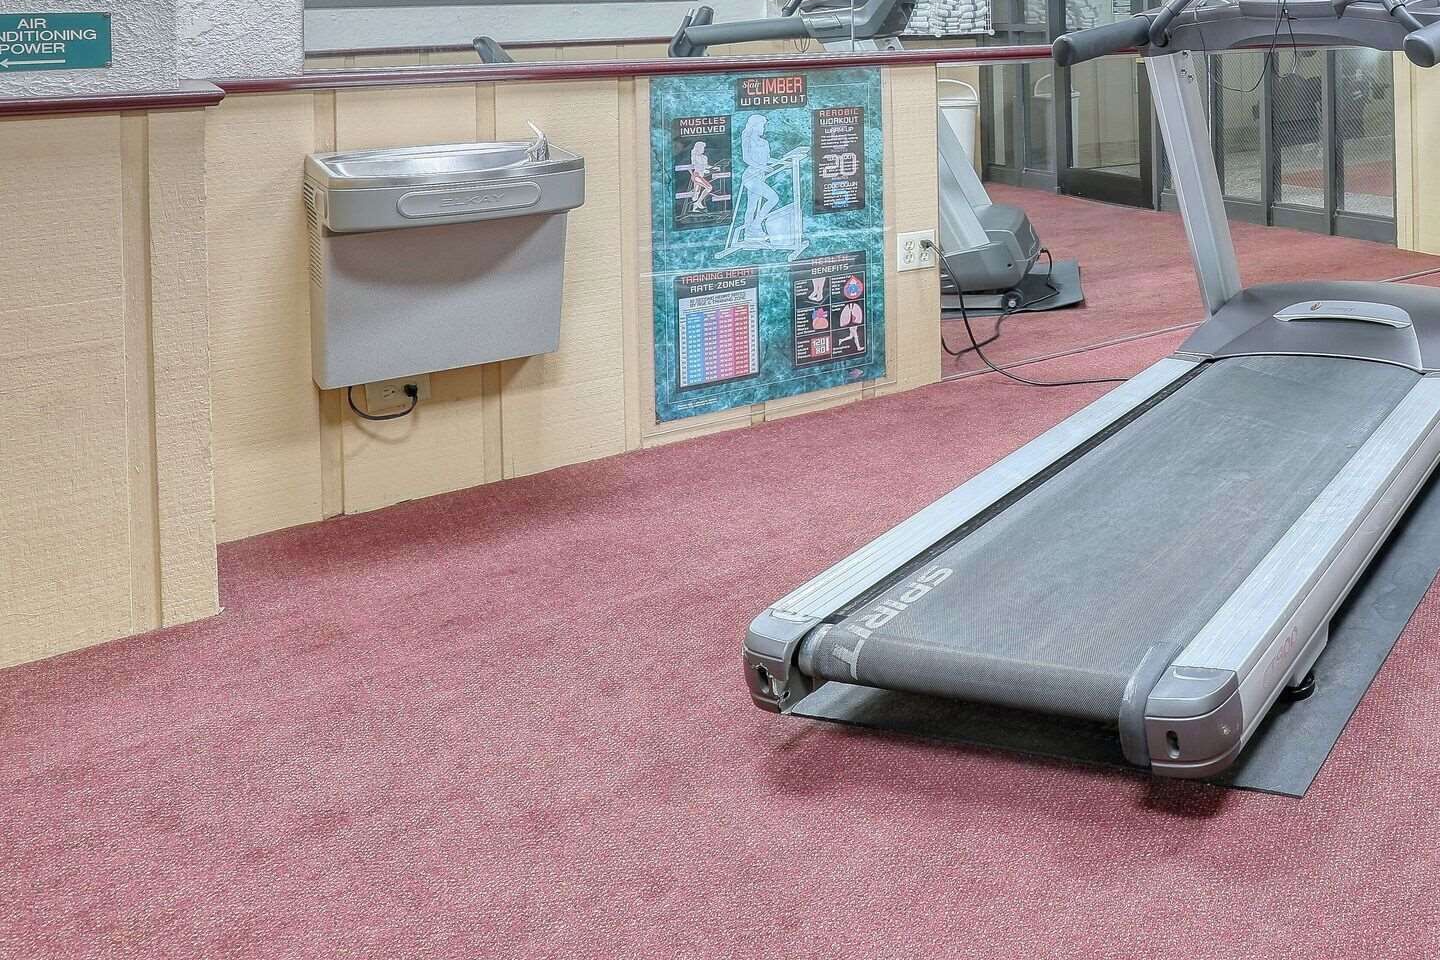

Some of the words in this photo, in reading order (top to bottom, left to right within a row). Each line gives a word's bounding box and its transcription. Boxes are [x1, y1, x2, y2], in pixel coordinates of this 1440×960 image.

[17, 18, 47, 29] AIR
[0, 29, 97, 42] NDITIONING
[0, 42, 65, 55] POWER
[747, 76, 803, 95] CLIMBER
[740, 94, 806, 106] WORKOUT
[819, 108, 859, 117] AEROBIC
[679, 116, 727, 127] MUSCLES
[819, 116, 859, 126] WORKOUT
[680, 125, 726, 135] INVOLVED
[811, 263, 849, 275] BENEFITS
[681, 272, 724, 285] TRAINING
[690, 283, 714, 294] RATE
[717, 278, 747, 289] ZONES
[832, 565, 953, 680] SPIRIT
